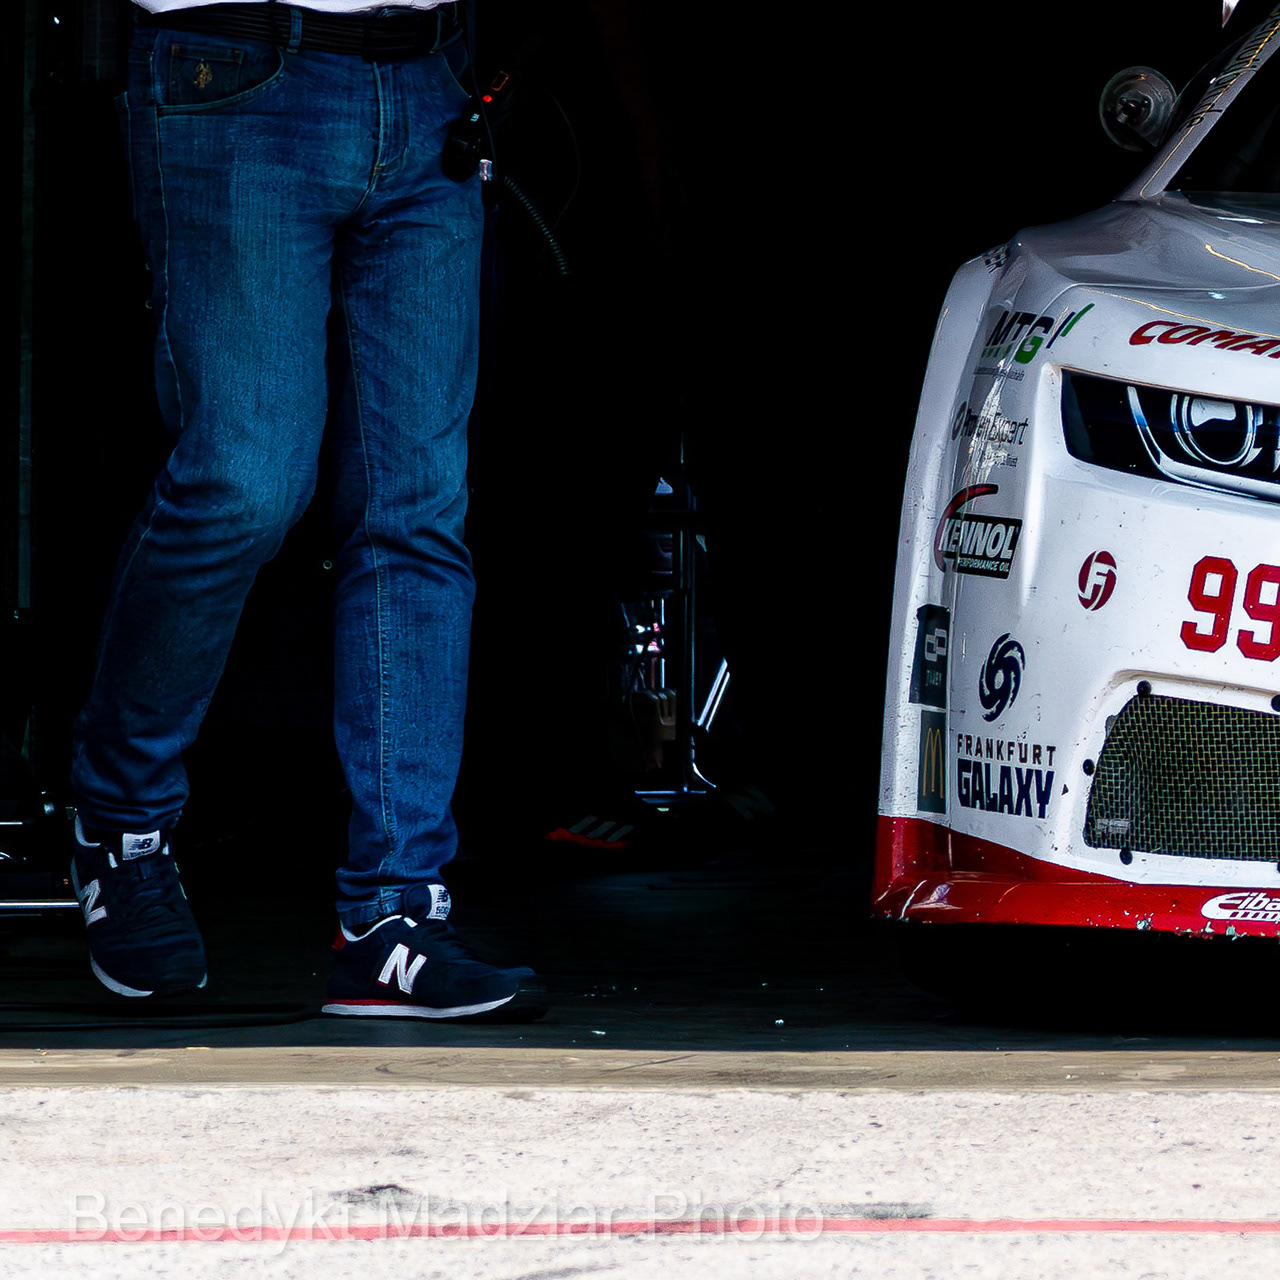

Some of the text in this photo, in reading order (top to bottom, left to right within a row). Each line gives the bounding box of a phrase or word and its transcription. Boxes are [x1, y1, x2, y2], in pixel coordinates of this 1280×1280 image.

[938, 518, 1015, 560] KENNOL
[957, 733, 1057, 763] FRANKFURT
[957, 759, 1056, 819] GALAXY
